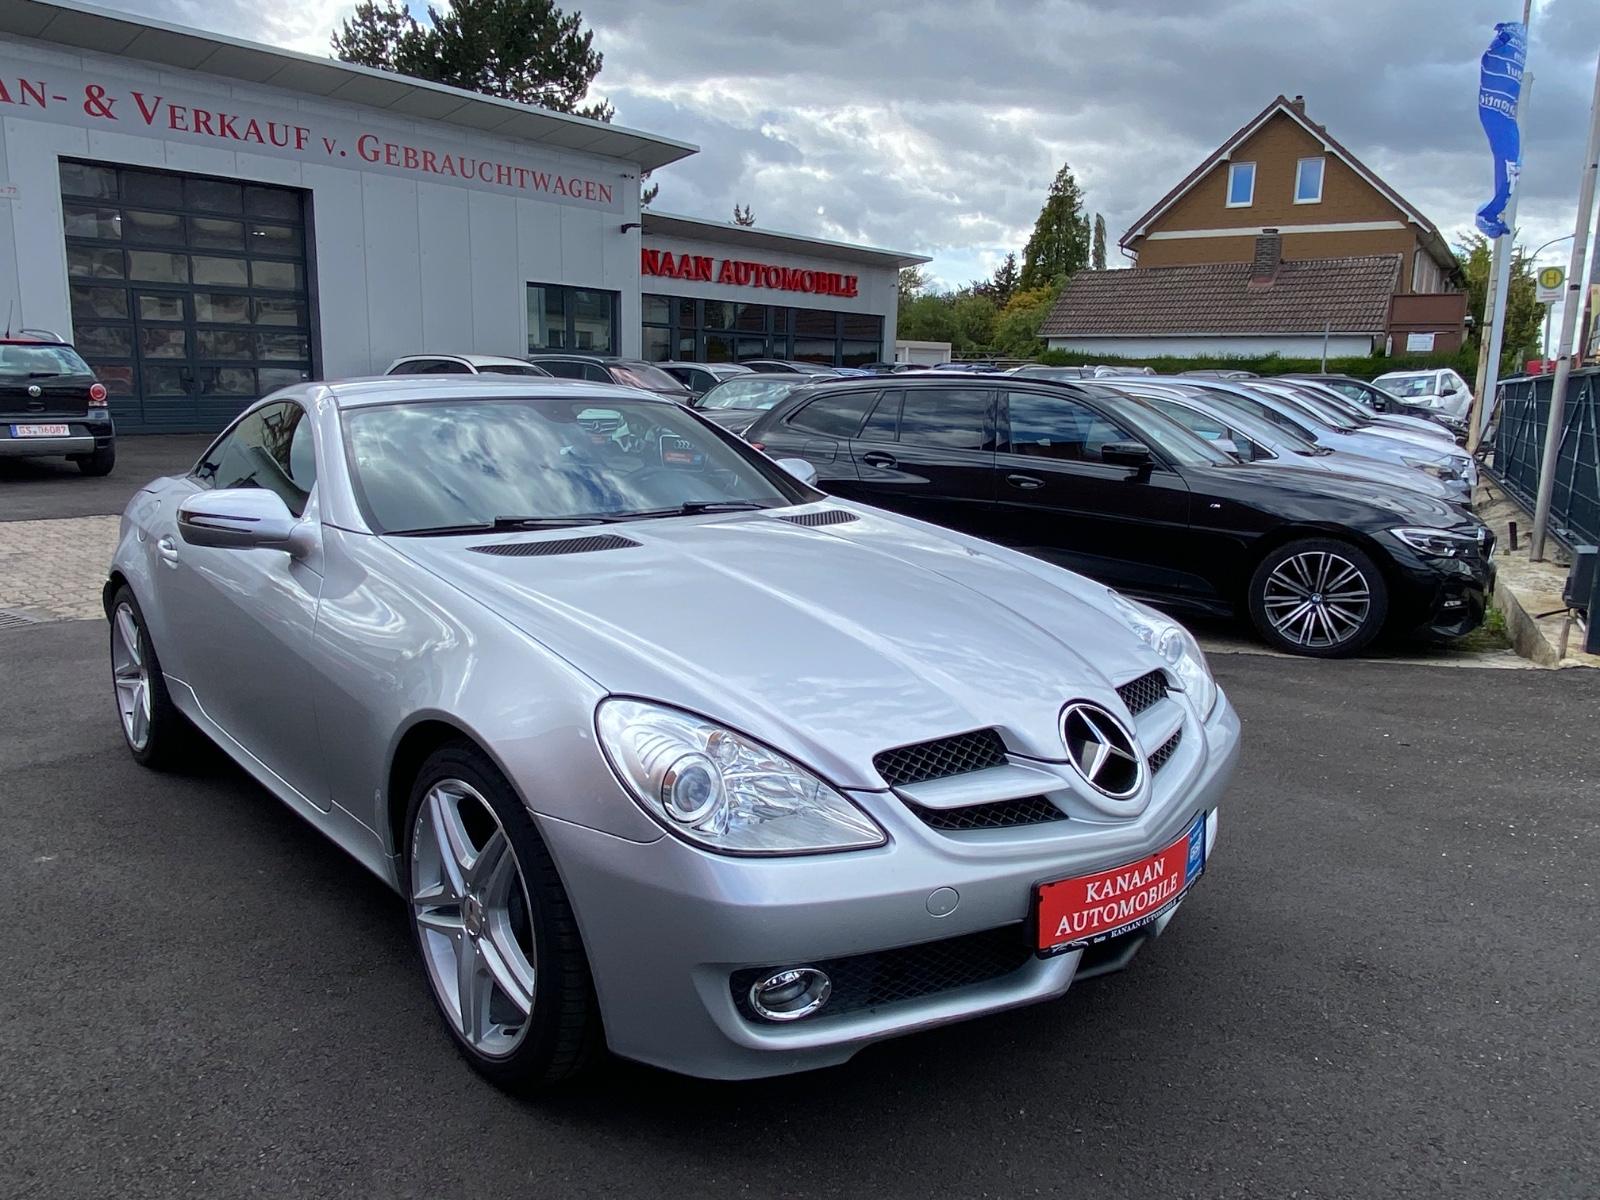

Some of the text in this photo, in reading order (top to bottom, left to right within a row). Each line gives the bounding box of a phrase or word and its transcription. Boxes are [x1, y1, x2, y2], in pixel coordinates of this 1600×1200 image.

[83, 84, 119, 121] &
[131, 91, 311, 151] VERKAUF
[357, 133, 614, 204] GEBRAUCHTWAGEN
[717, 259, 859, 297] AUTOMOBILE
[1546, 272, 1557, 285] H
[1085, 857, 1166, 904] KANAAN
[1055, 871, 1179, 937] AUTOMOBILE
[1110, 921, 1141, 938] KANAAN
